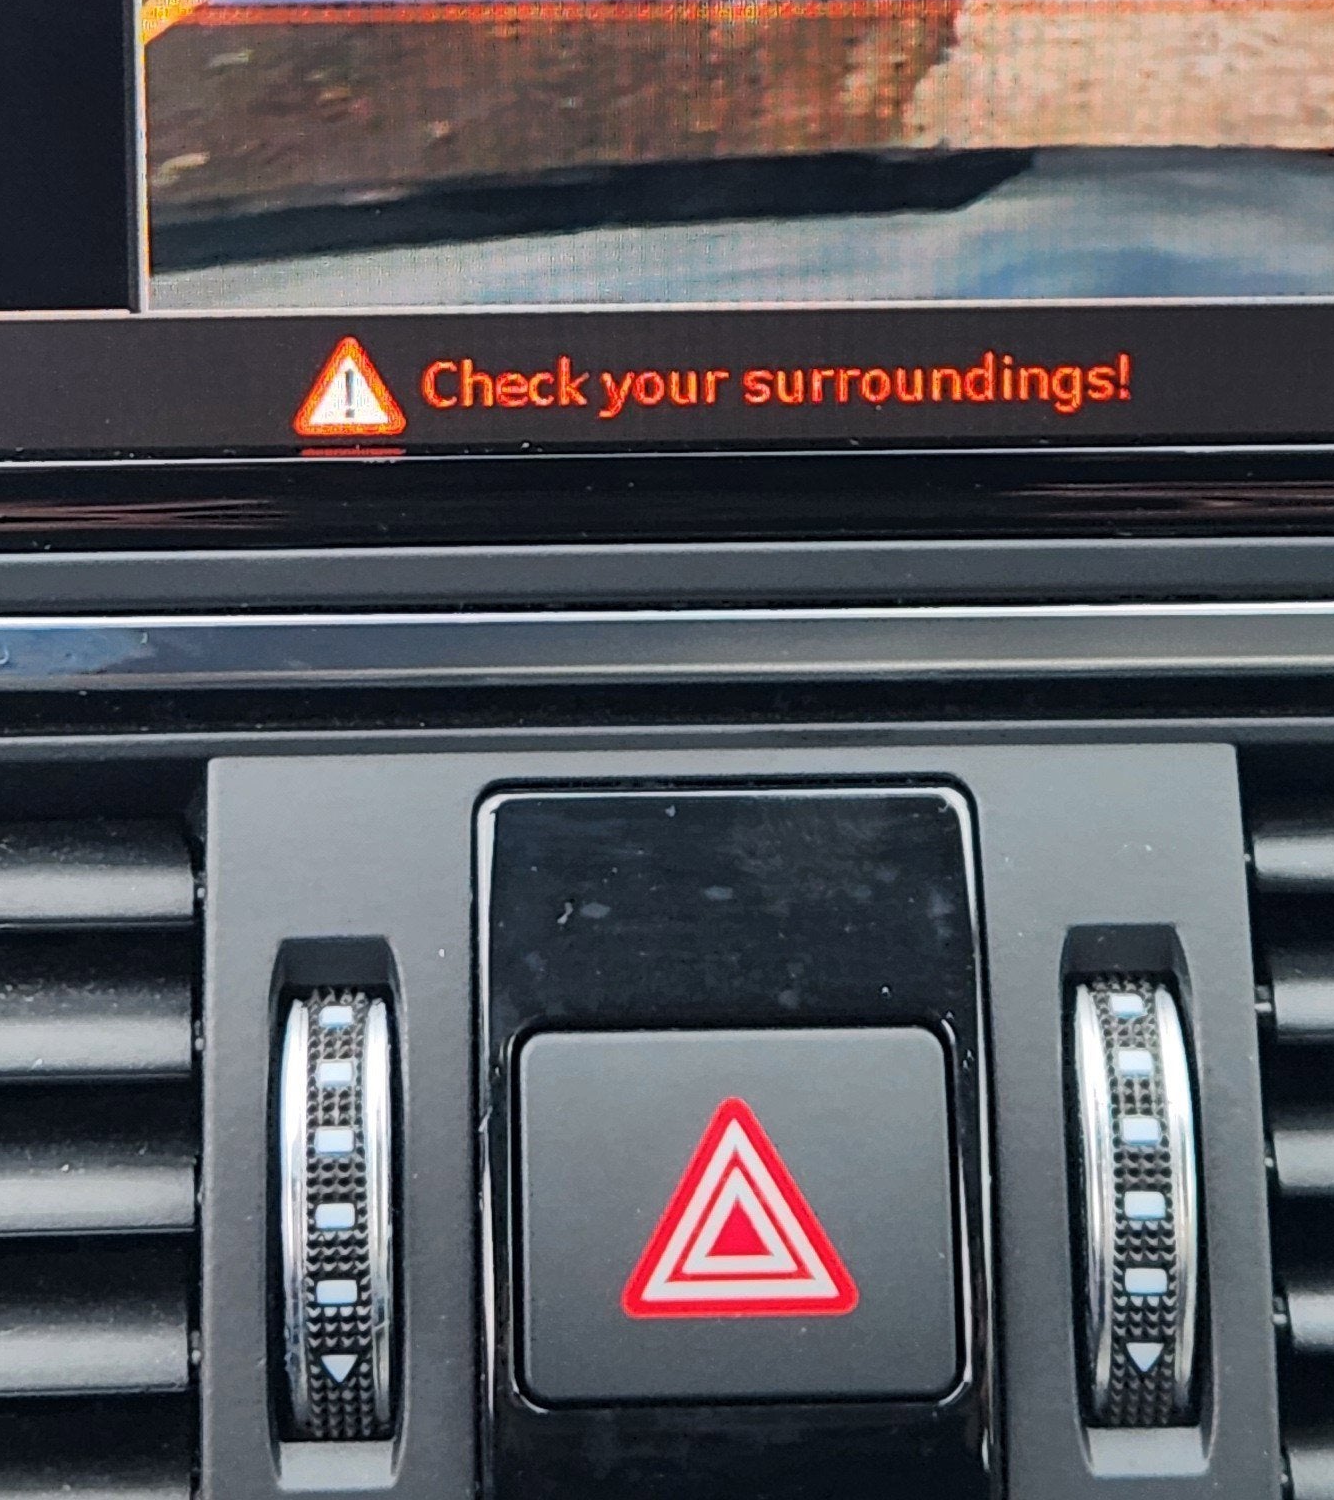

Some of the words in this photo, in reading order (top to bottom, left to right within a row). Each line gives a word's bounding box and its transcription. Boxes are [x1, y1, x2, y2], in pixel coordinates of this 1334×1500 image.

[421, 355, 589, 409] Check
[599, 367, 729, 419] your
[743, 351, 1133, 414] surroundings!
